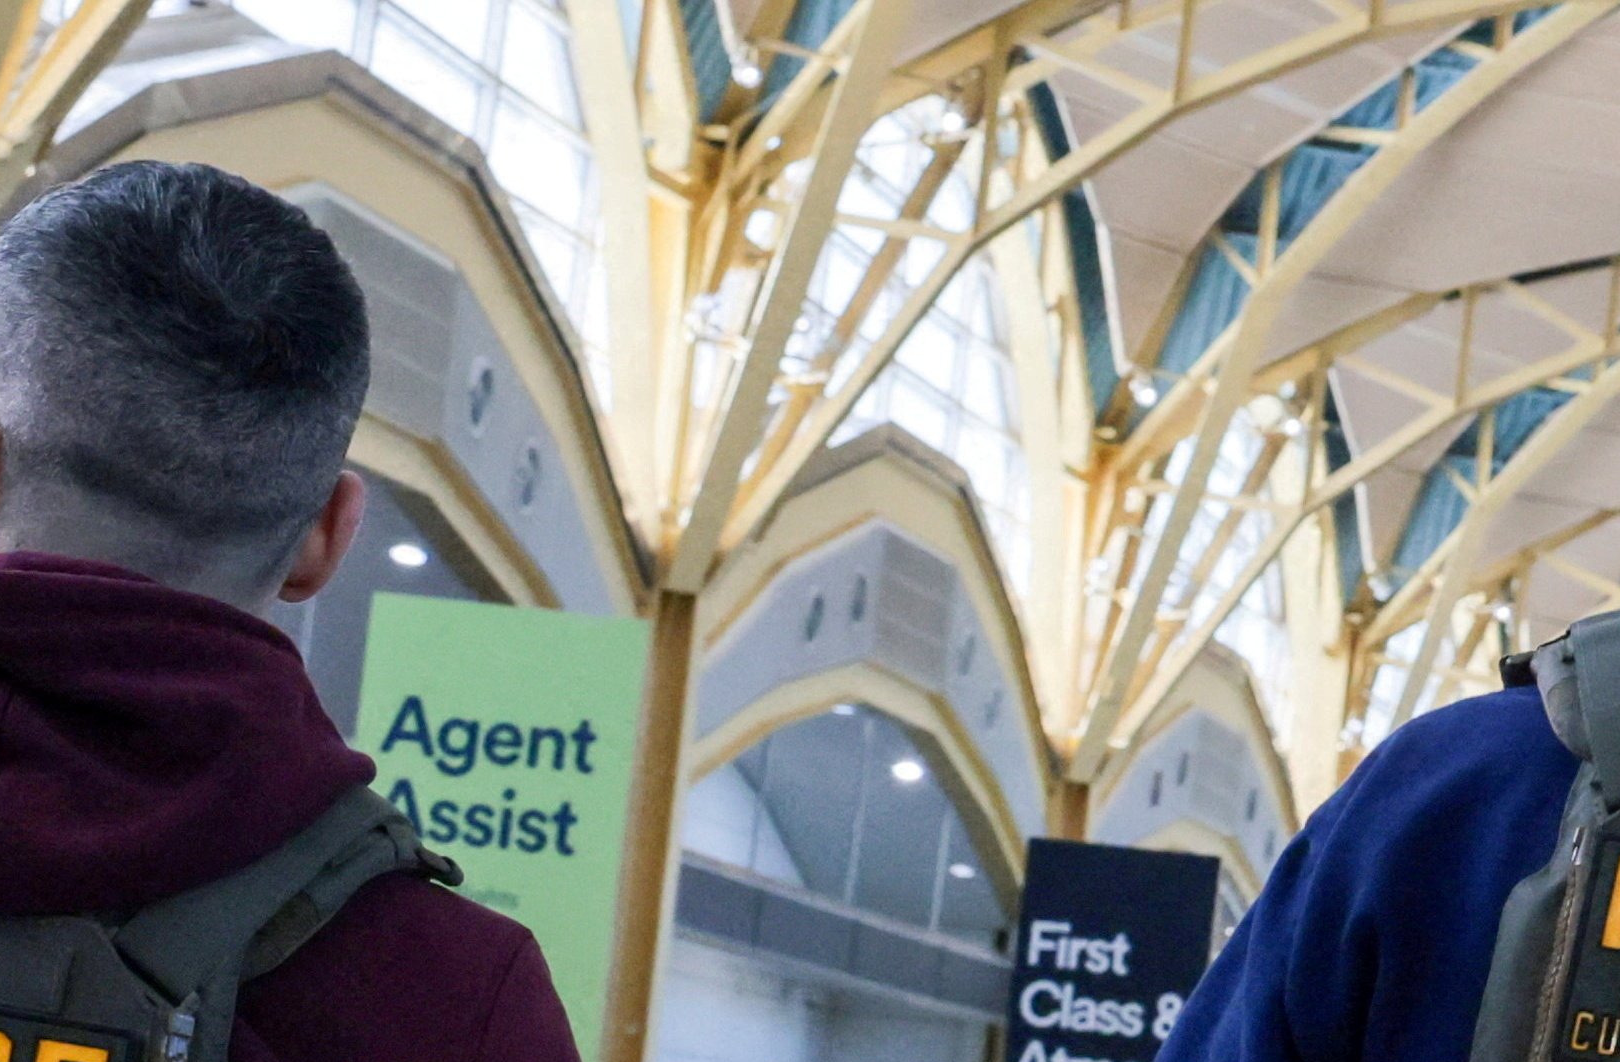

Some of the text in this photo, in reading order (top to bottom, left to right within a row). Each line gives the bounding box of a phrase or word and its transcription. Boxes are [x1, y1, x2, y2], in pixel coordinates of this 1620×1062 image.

[381, 695, 597, 776] Agent
[1028, 919, 1131, 976] First
[1020, 979, 1144, 1037] Class
